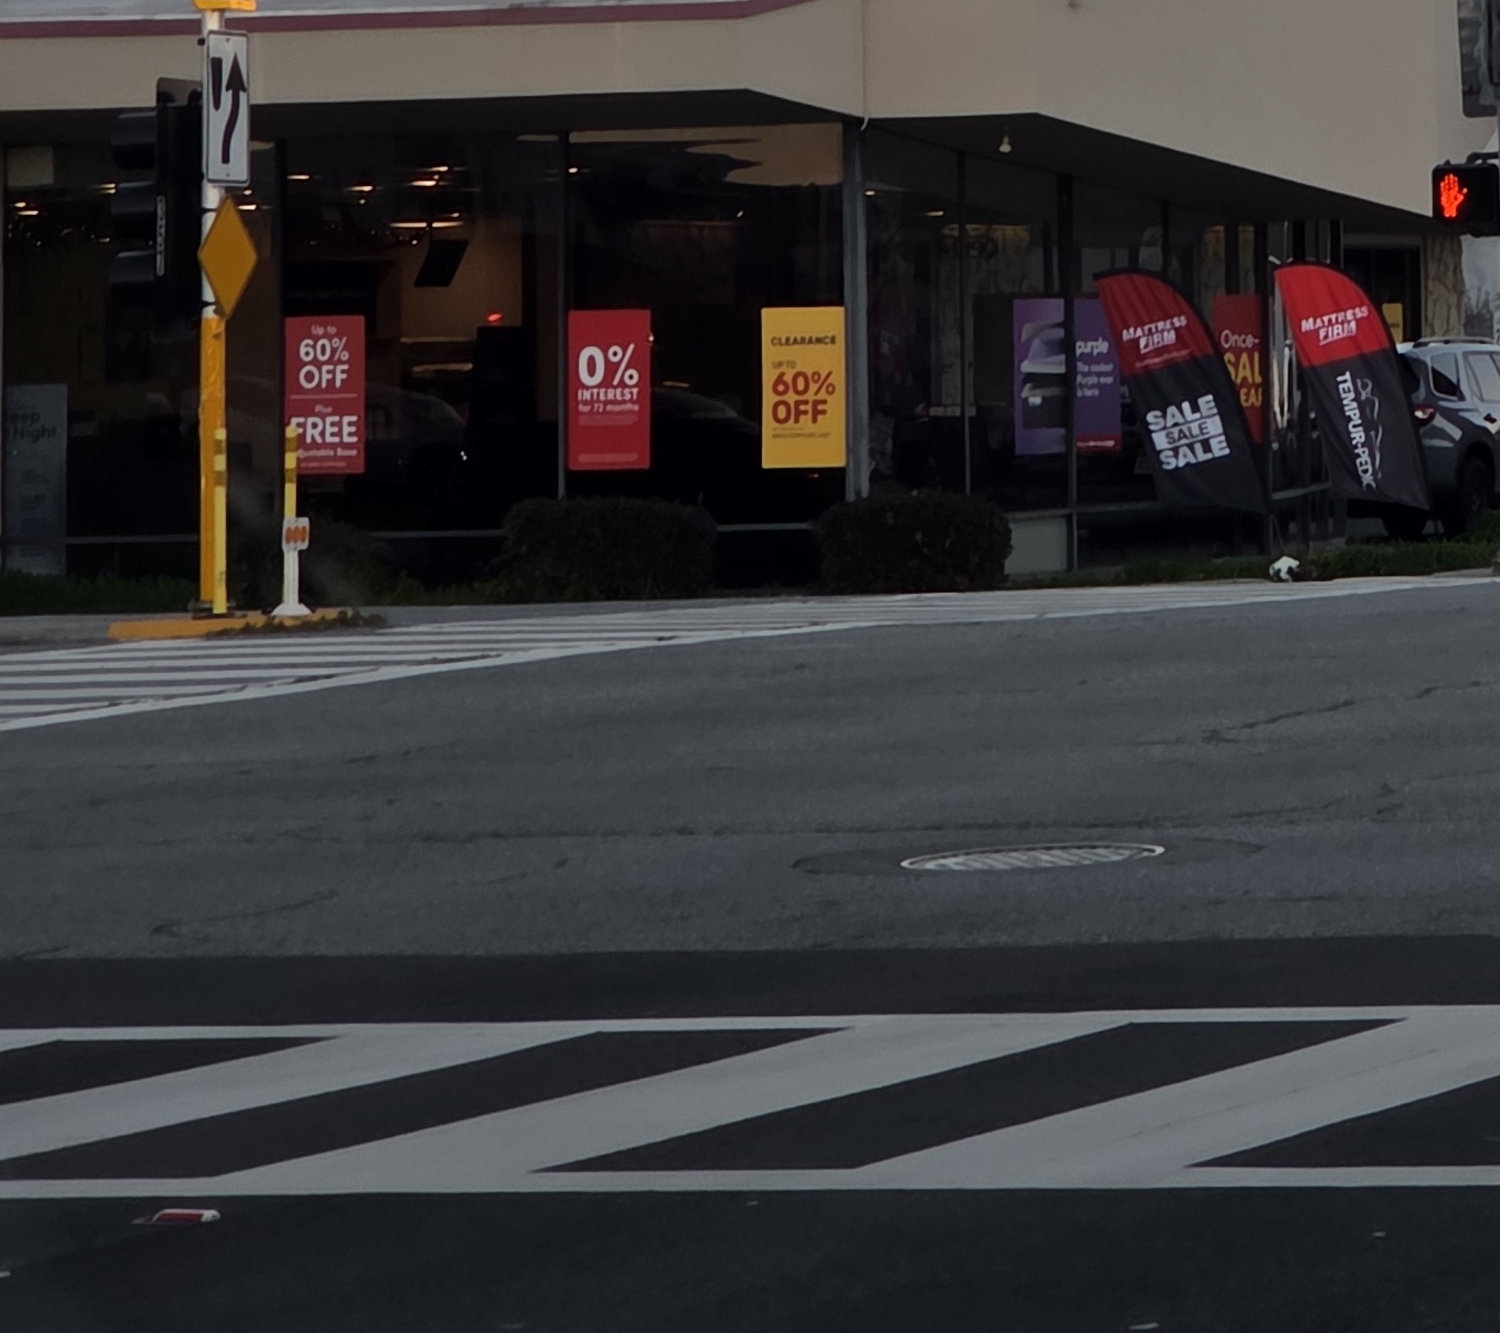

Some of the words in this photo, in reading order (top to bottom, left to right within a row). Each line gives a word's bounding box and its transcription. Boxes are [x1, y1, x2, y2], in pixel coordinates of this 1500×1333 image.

[1122, 315, 1188, 342] MATTRESS
[1301, 305, 1369, 333] MATTRESS
[1319, 320, 1357, 343] FIRM
[299, 336, 349, 362] 60%
[771, 335, 836, 347] CLEARANCE
[1075, 337, 1109, 357] purple
[1139, 329, 1176, 352] FIRM
[299, 364, 349, 389] OFF
[578, 343, 639, 386] 0%
[1223, 351, 1262, 384] SAL
[578, 387, 639, 402] INTEREST
[772, 370, 836, 397] 60%
[772, 399, 828, 425] OFF
[1146, 394, 1218, 431] SALE
[290, 415, 358, 444] FREE
[1165, 421, 1210, 445] SALE
[1159, 435, 1230, 471] SALE
